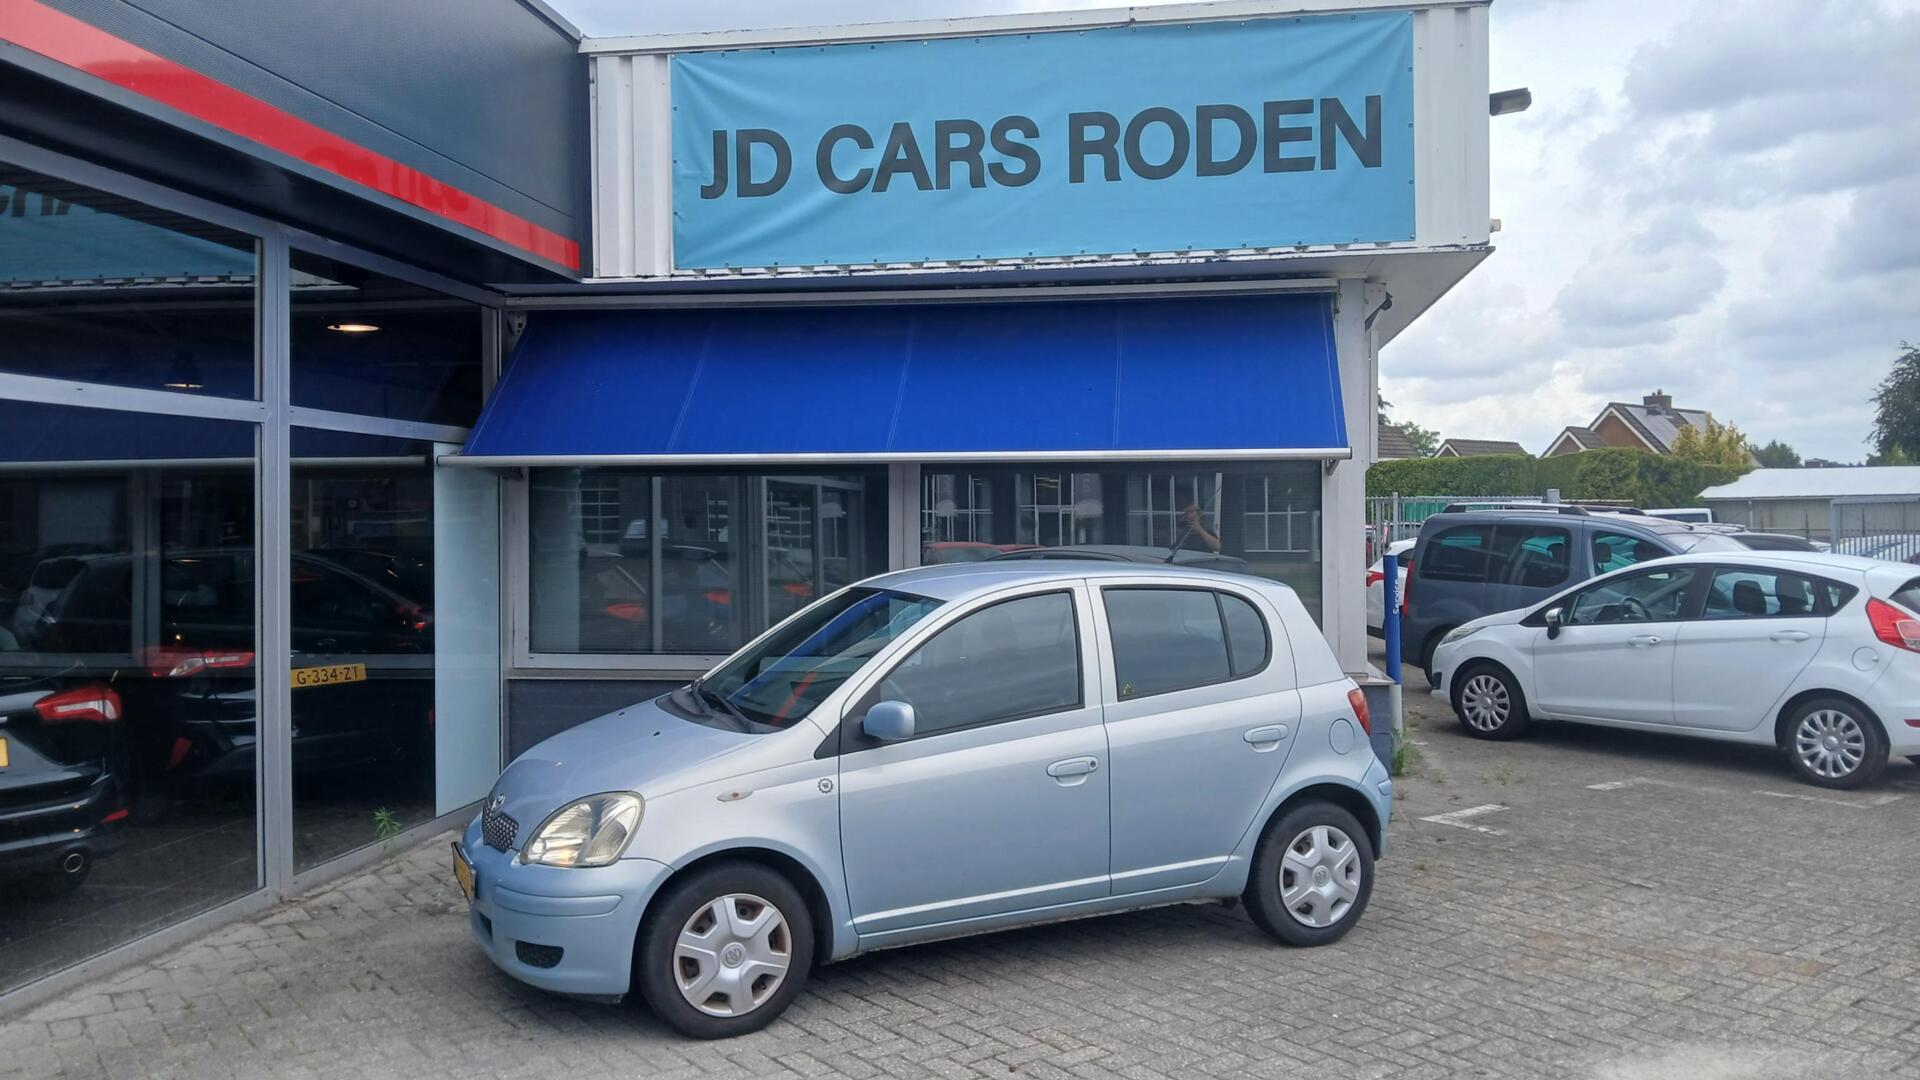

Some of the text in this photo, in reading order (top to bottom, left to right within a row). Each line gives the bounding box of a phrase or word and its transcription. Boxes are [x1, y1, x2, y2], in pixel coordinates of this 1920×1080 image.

[701, 95, 1381, 199] JD CARS RODEN
[296, 666, 358, 685] G-334-ZT
